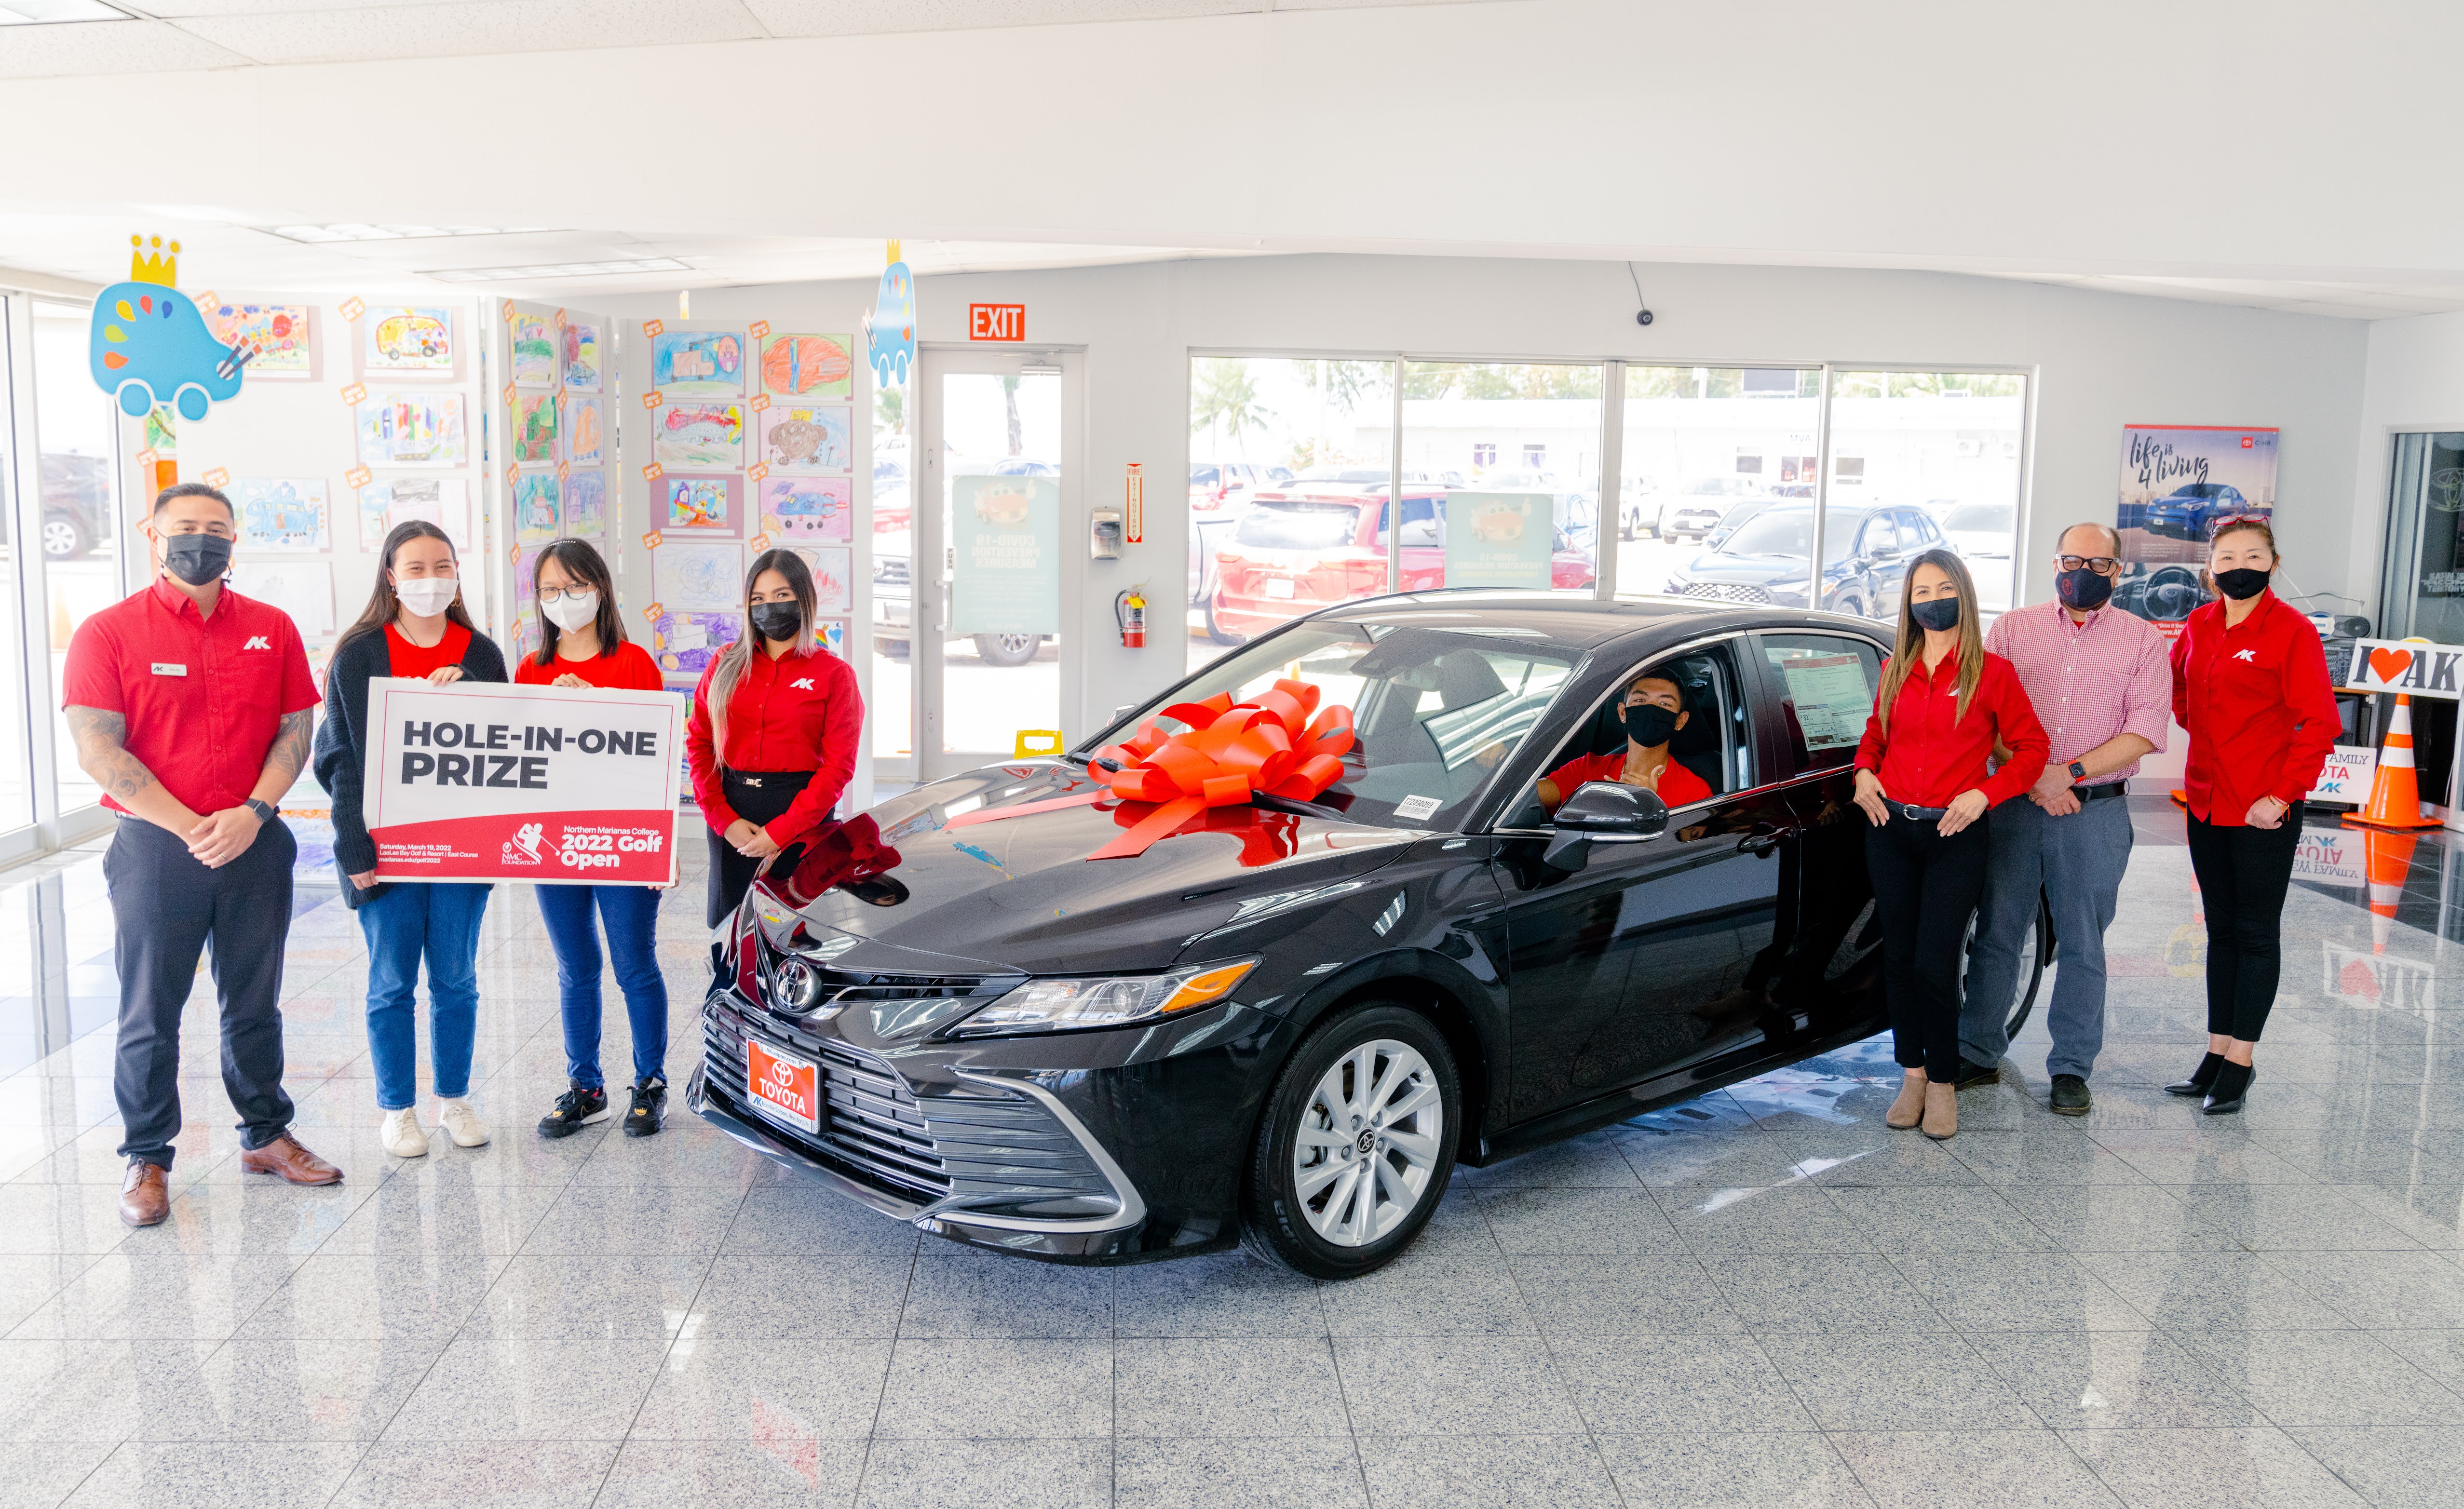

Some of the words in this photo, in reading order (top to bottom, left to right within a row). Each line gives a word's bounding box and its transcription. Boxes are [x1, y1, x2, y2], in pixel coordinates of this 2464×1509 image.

[973, 307, 1022, 338] EXIT
[2130, 433, 2160, 469] life
[2165, 444, 2173, 456] is
[2139, 469, 2152, 489] 4
[2156, 450, 2208, 485] living
[244, 636, 271, 650] AK
[2232, 649, 2257, 662] AK
[2400, 650, 2462, 692] AK
[789, 678, 815, 690] AK
[403, 720, 657, 756] HOLE-IN-ONE
[401, 752, 549, 789] PRIZE
[2318, 782, 2343, 794] AK
[1404, 798, 1434, 808] T22090099
[564, 825, 596, 834] Northern
[631, 827, 659, 836] College
[561, 834, 613, 851] 2022
[618, 835, 663, 852] Golf
[561, 850, 620, 870] Open
[759, 1077, 806, 1114] TOYOTA
[753, 1096, 762, 1107] AK
[762, 1101, 770, 1109] Here
[788, 1112, 797, 1121] Here
